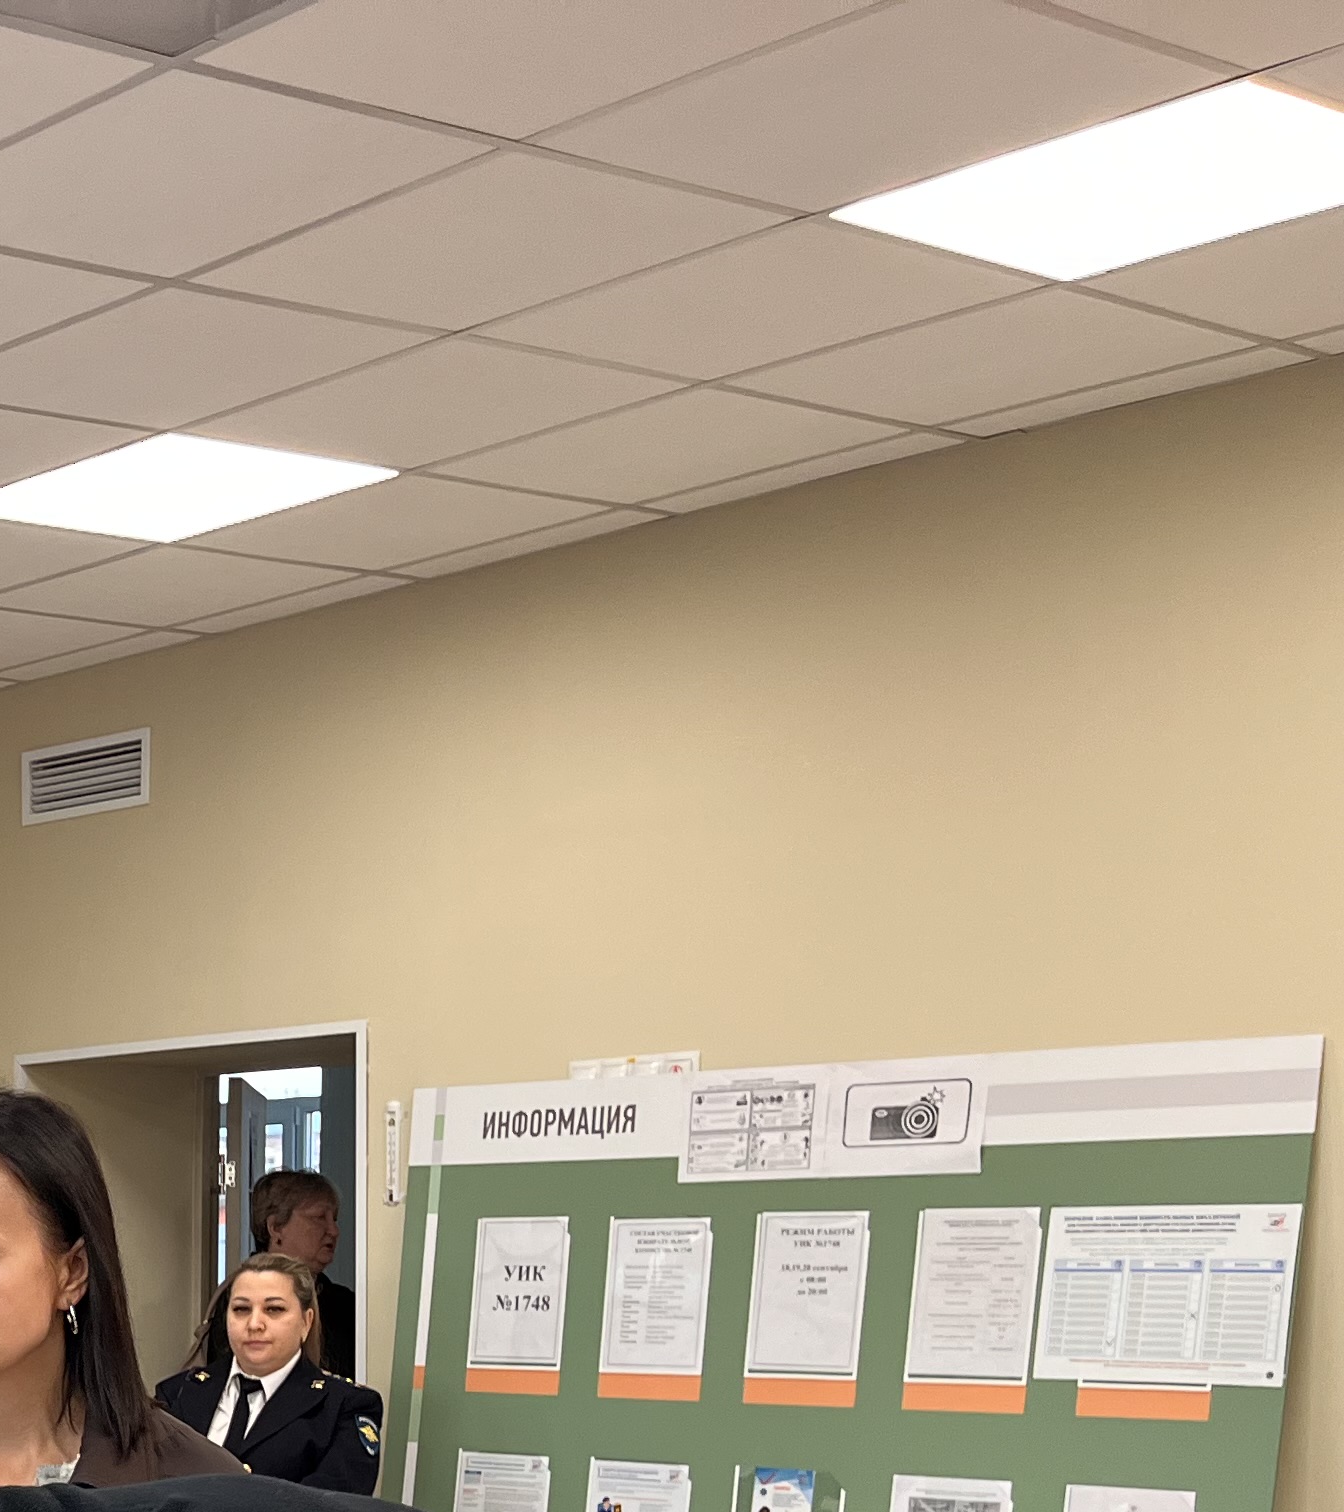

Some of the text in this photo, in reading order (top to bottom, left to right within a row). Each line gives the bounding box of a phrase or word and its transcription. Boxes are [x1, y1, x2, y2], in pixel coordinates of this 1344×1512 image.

[482, 1104, 636, 1139] ИНФОРМАЦИЯ
[504, 1265, 546, 1282] УИК
[493, 1295, 550, 1312] №1748
